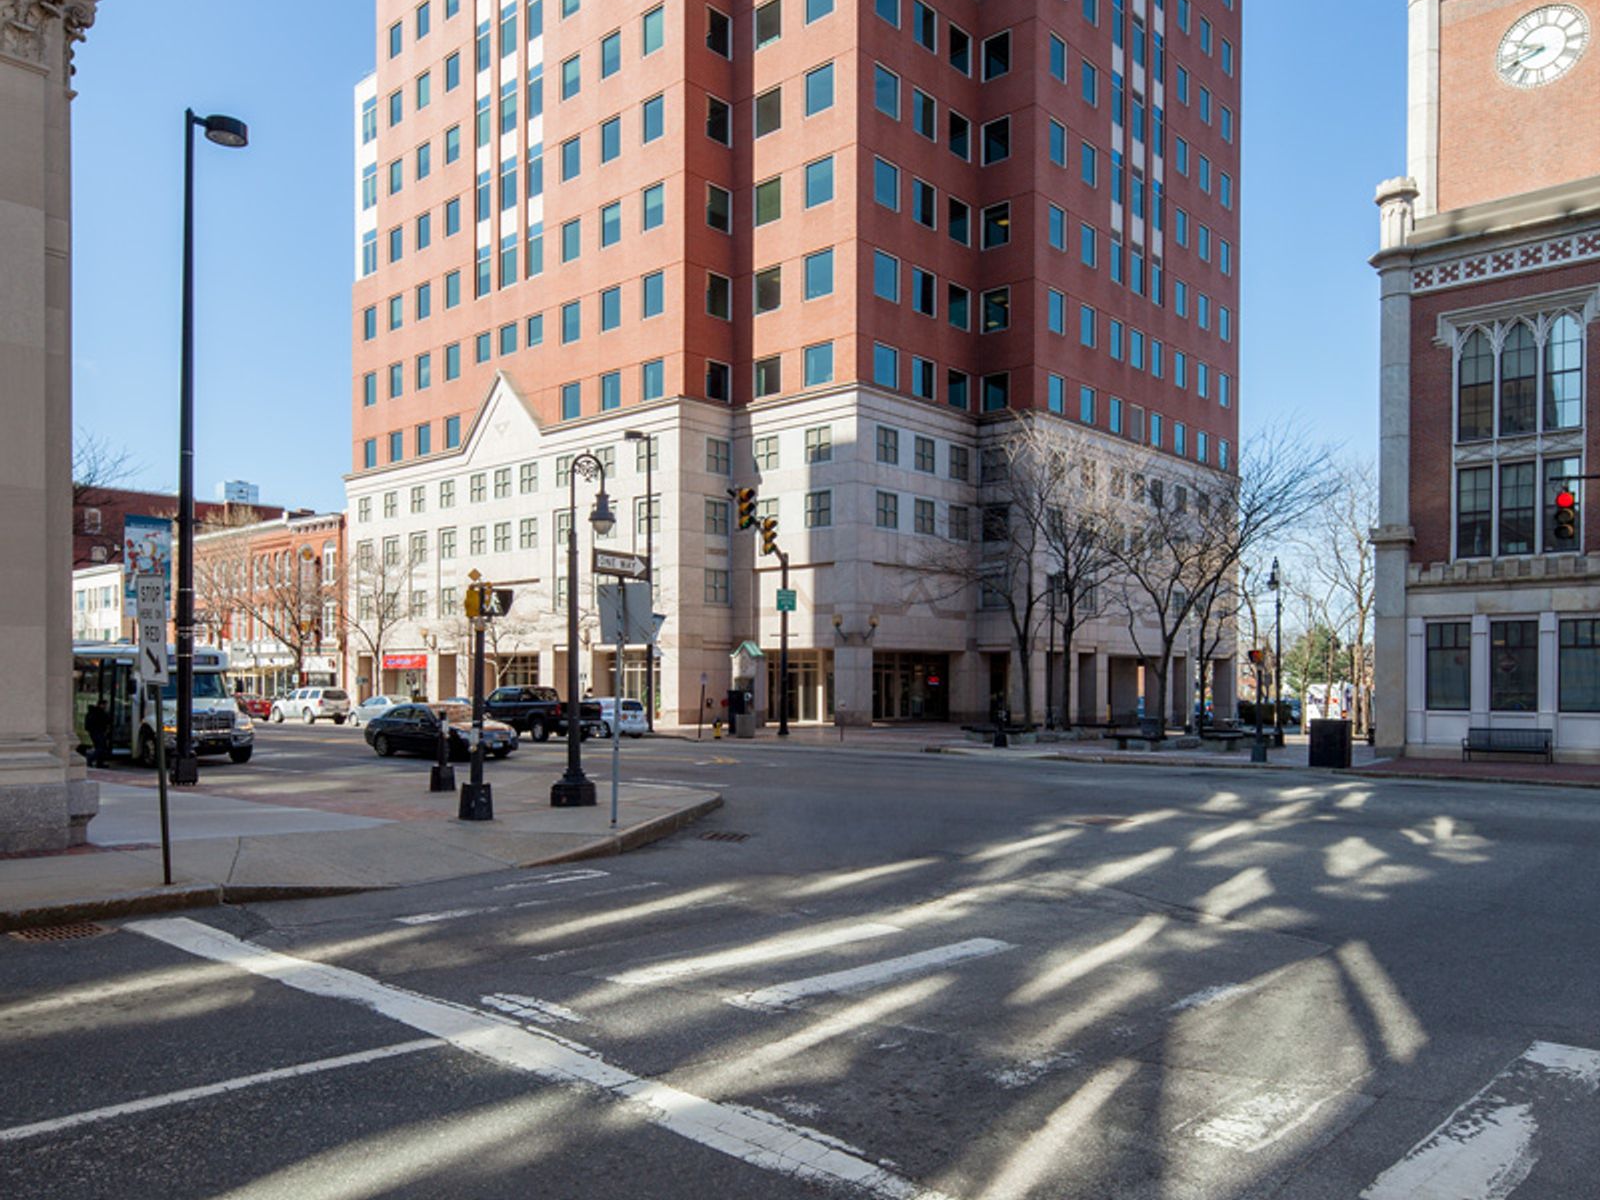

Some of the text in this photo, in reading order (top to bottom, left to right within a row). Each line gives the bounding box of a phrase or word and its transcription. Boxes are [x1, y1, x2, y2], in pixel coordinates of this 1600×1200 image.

[599, 555, 637, 570] ONE WAY
[141, 585, 160, 602] STOP
[144, 625, 161, 643] RED
